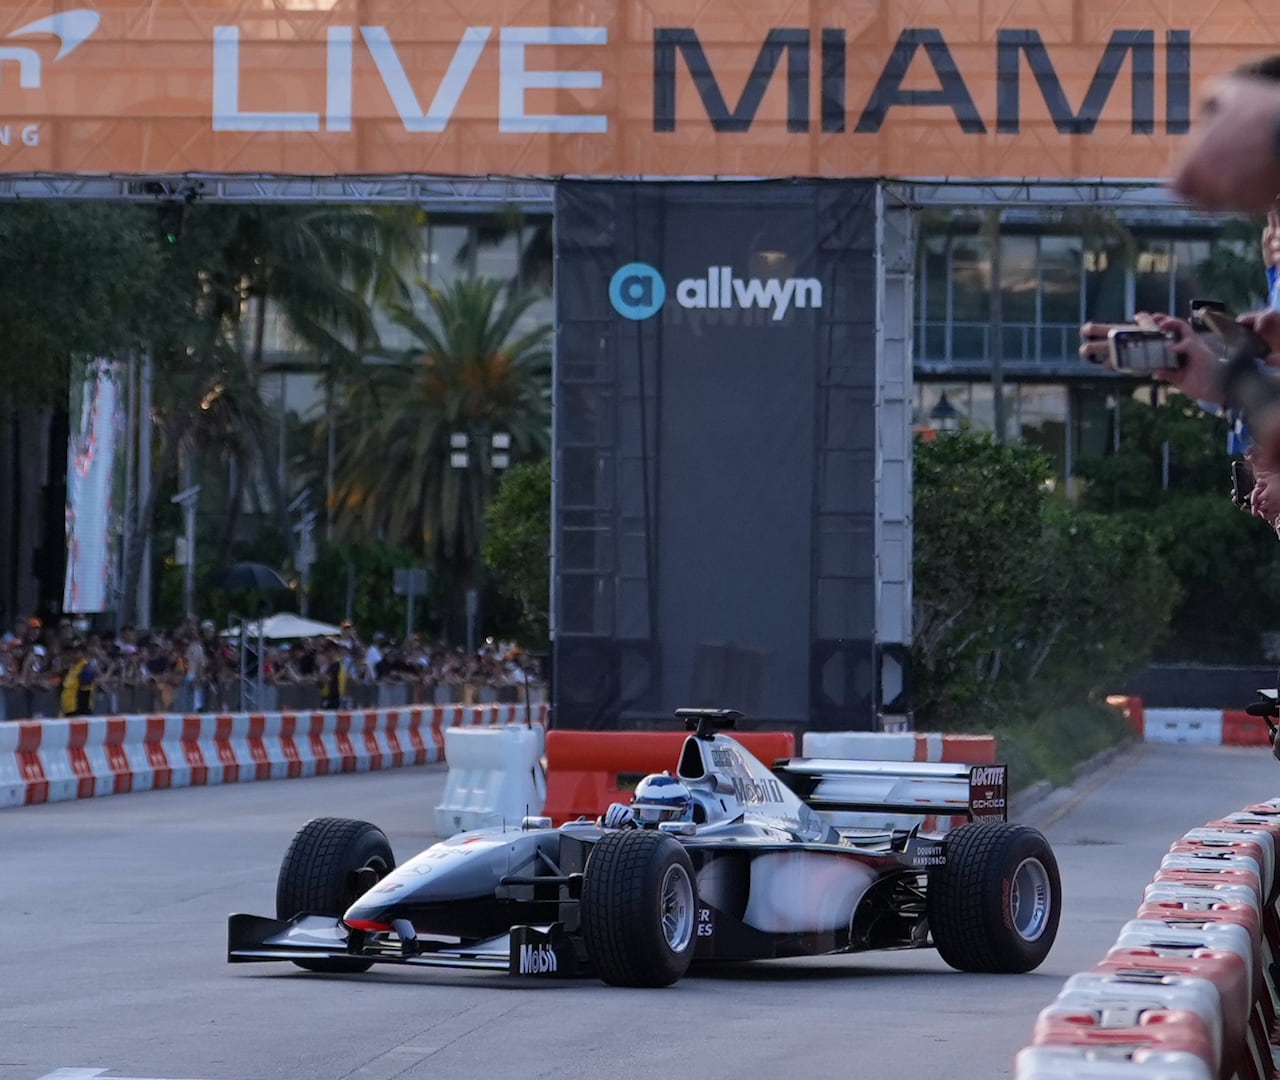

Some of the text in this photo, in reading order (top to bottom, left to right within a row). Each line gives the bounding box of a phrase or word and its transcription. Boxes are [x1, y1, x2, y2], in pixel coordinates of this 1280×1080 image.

[212, 26, 1191, 135] LIVE MIAMI
[676, 266, 823, 321] allwyn
[731, 777, 770, 803] Mobil
[971, 767, 1005, 786] LOCTITE
[520, 944, 557, 974] Mobil
